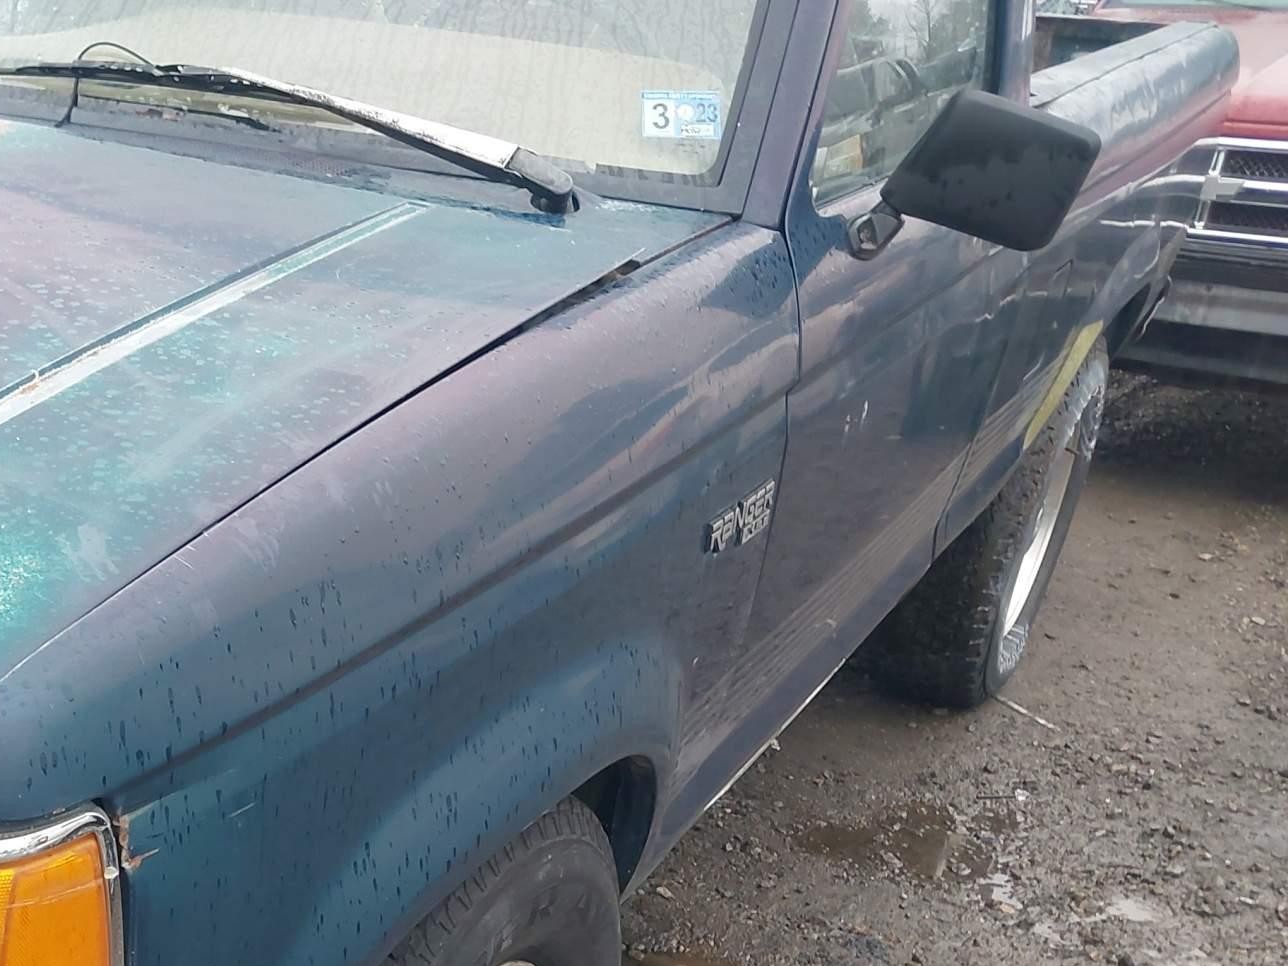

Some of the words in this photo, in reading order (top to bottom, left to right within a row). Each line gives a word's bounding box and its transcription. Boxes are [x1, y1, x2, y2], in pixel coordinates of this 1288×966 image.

[652, 103, 670, 129] 3
[696, 104, 718, 122] 23
[710, 480, 775, 551] RANGER
